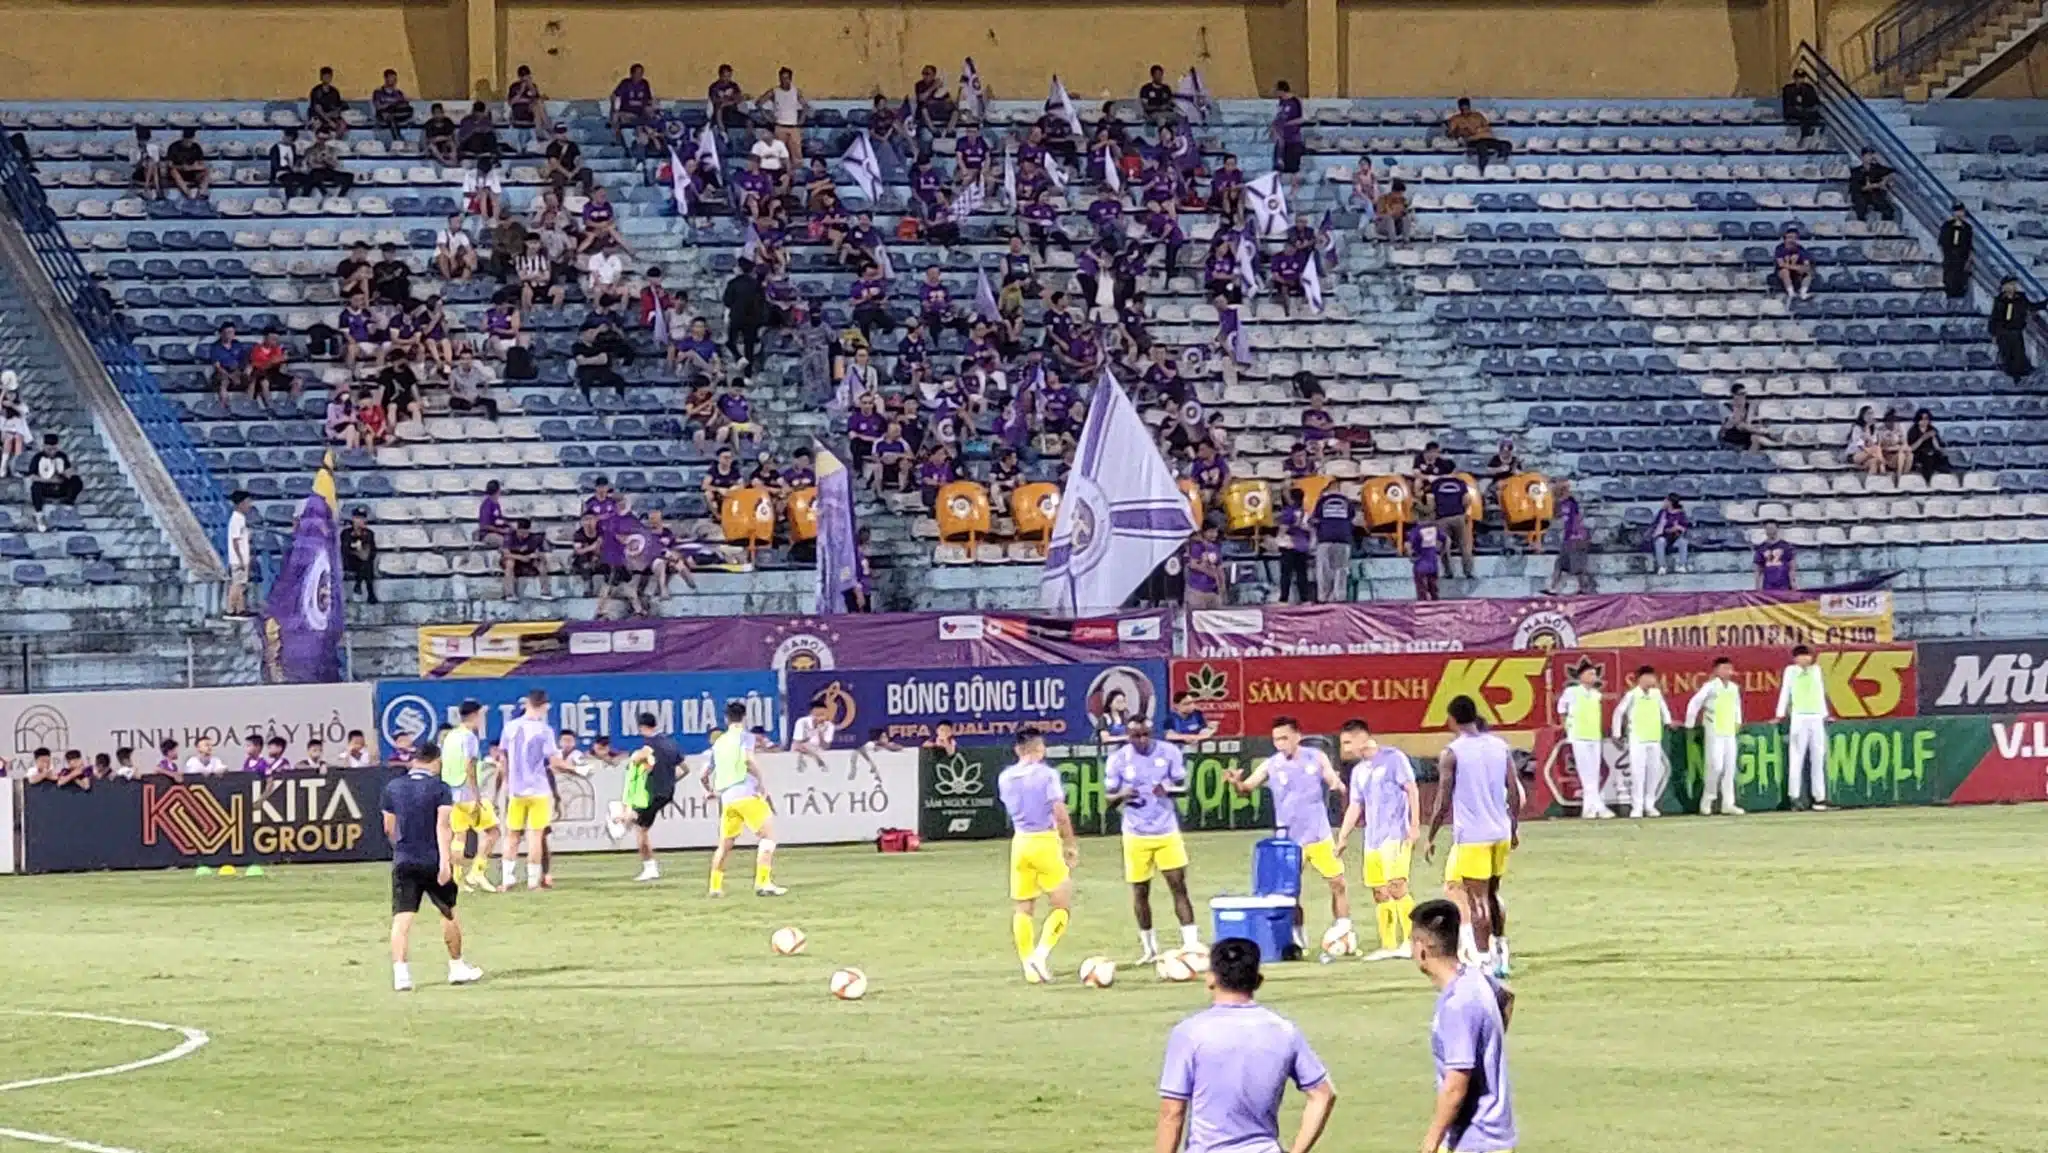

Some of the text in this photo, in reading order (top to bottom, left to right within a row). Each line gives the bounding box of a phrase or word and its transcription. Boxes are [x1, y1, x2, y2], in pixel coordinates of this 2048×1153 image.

[1523, 614, 1568, 633] HANOI
[1643, 627, 1709, 647] HANOI
[781, 639, 825, 654] HANOI
[886, 674, 1065, 718] BÓNG ĐỘNG LỰC
[1249, 677, 1429, 704] SÂM NGỌC LINH
[1420, 657, 1547, 728] K5
[1745, 670, 1785, 693] LIN
[308, 709, 345, 744] HỒ
[887, 724, 930, 738] FIFA
[951, 720, 1019, 737] UALITY
[1827, 731, 1936, 793] WOLF
[252, 777, 363, 824] KITA
[784, 786, 841, 815] TÂY
[253, 822, 363, 855] GROUP
